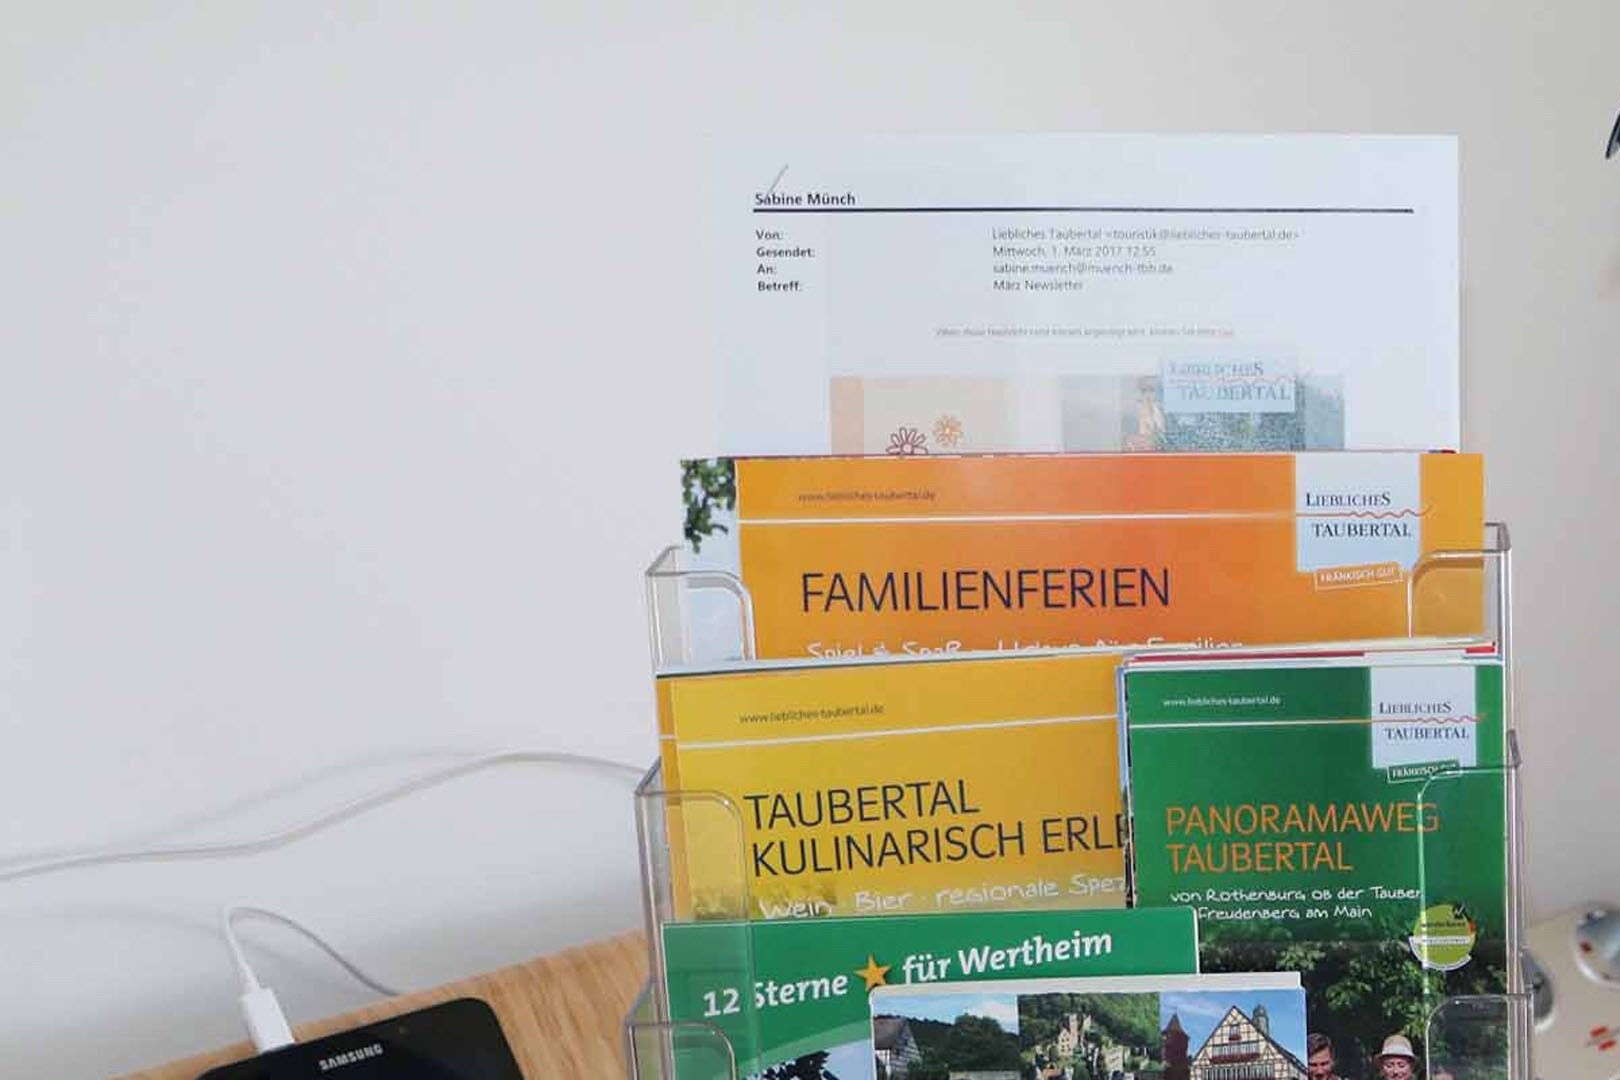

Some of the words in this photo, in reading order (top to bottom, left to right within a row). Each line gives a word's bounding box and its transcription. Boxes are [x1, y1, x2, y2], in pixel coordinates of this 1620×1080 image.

[755, 193, 802, 206] Sabine
[807, 192, 856, 206] Münch
[756, 229, 784, 240] Von:
[992, 228, 1045, 241] Liebliches
[1049, 228, 1102, 241] Taubertal
[756, 247, 815, 259] Gesendet:
[1063, 245, 1092, 257] März
[757, 264, 777, 275] An:
[757, 281, 802, 292] Betreff:
[993, 279, 1020, 291] März
[1024, 279, 1084, 291] Newsletter
[1312, 523, 1412, 538] TAUBERTAL
[801, 567, 1170, 613] FAMILIENFERIEN
[1385, 727, 1470, 741] TAUBERTAL
[744, 778, 980, 831] TAUBERTAL
[1166, 803, 1440, 836] PANORAMAWEG
[752, 820, 1025, 877] KULINARISCH
[1166, 841, 1354, 875] TAUBERTAL
[854, 890, 913, 911] Bier
[935, 878, 1059, 905] regionale
[1170, 890, 1201, 903] von
[1337, 888, 1364, 901] der
[1306, 907, 1328, 918] am
[1334, 906, 1372, 919] Main
[703, 990, 740, 1017] 12
[754, 973, 848, 1009] Sterne
[902, 955, 951, 986] für
[958, 930, 1112, 978] Wertheim
[319, 1043, 383, 1072] SAMSUNG
